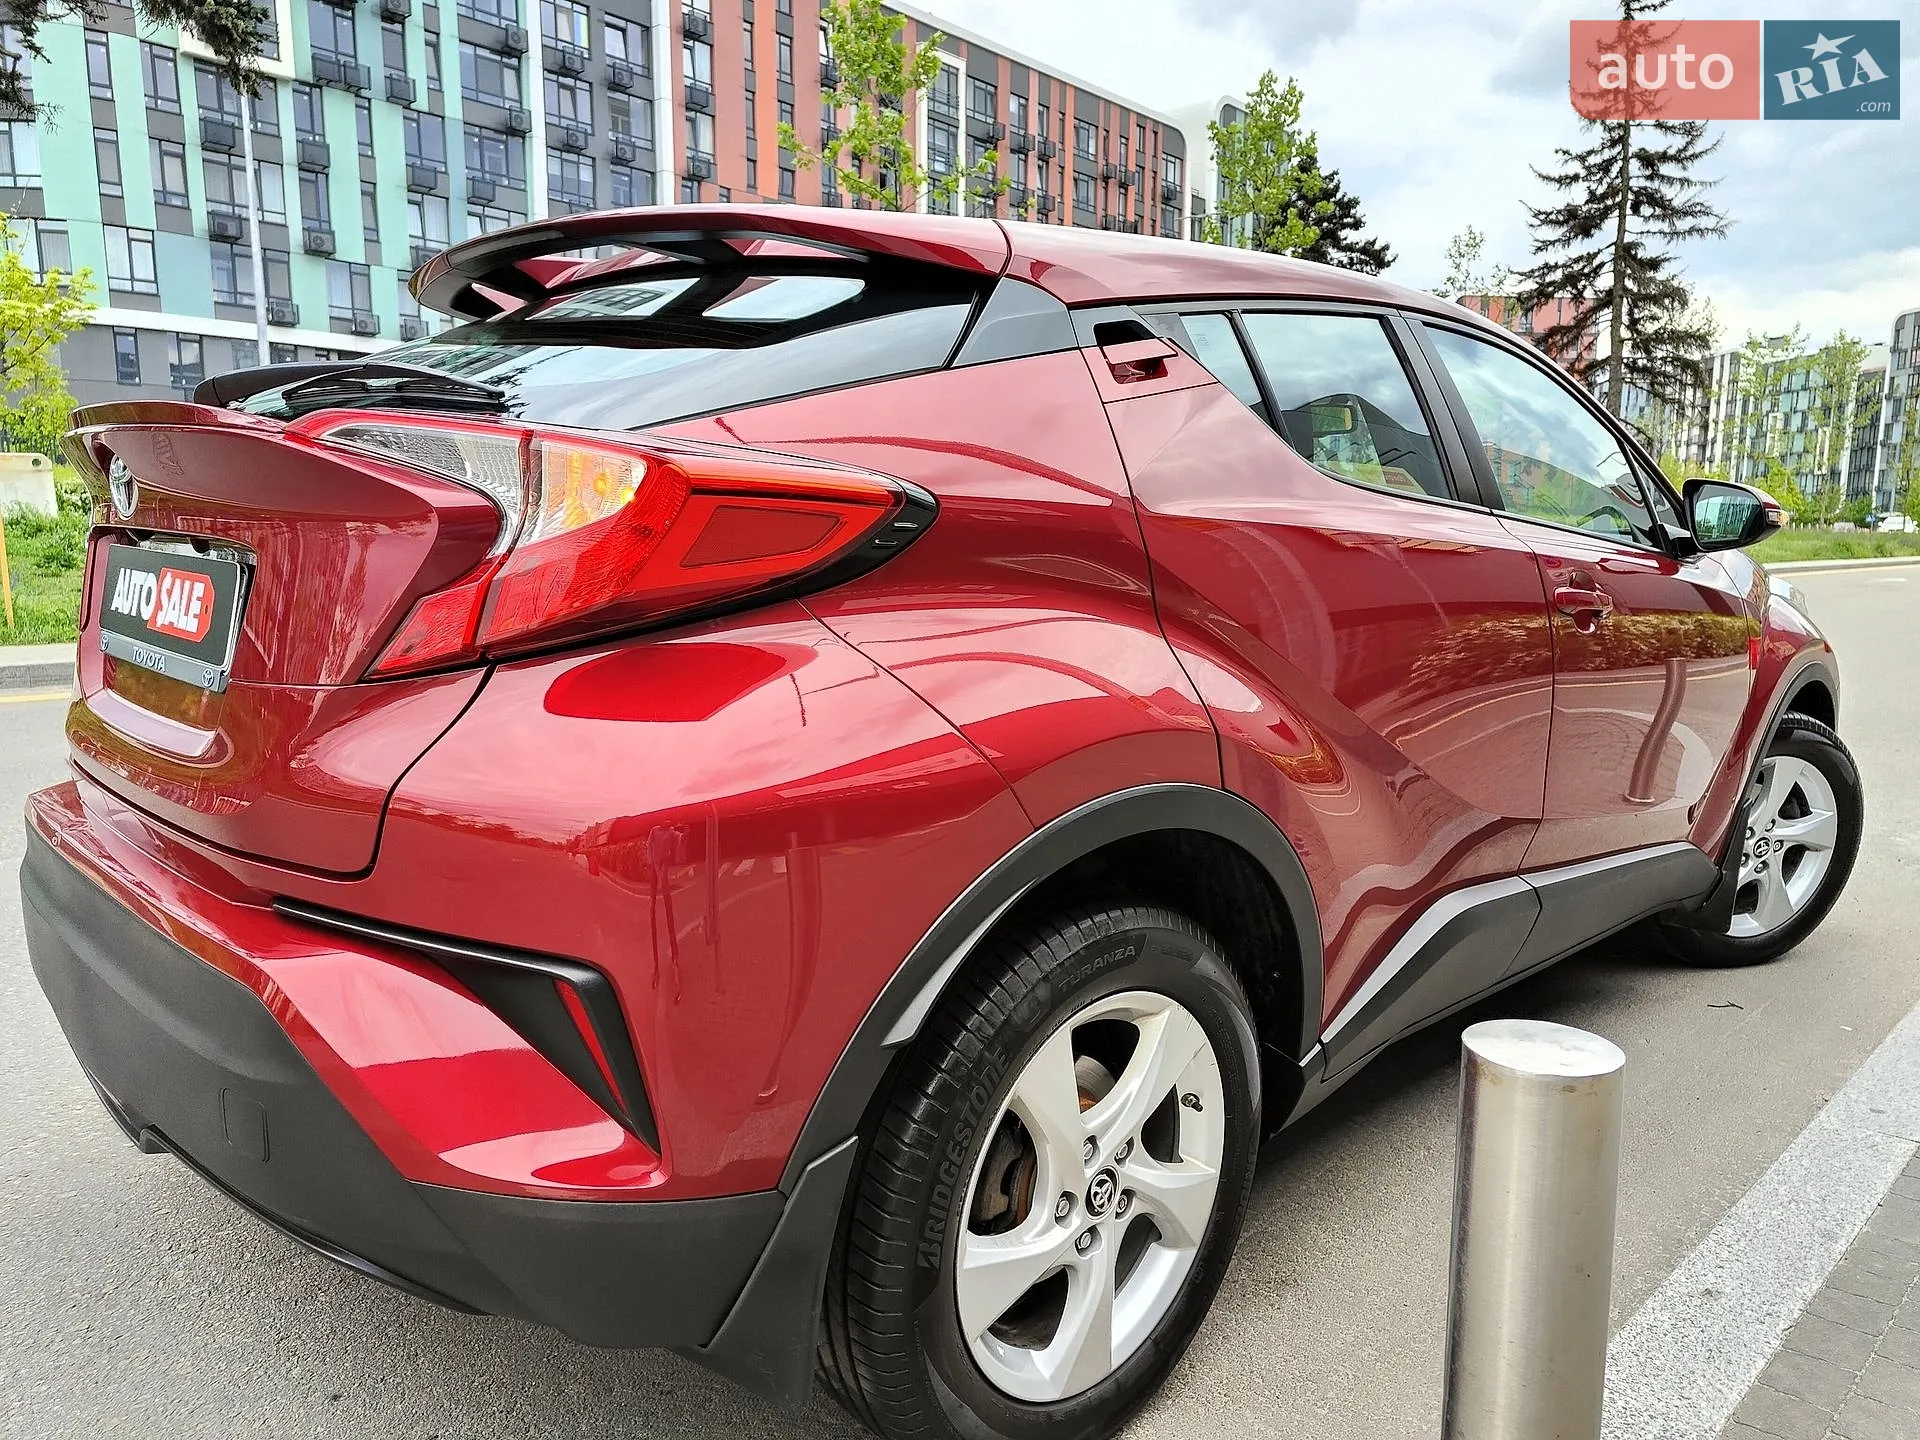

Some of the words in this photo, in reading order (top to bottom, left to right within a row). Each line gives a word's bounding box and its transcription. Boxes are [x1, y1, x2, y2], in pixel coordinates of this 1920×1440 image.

[110, 567, 156, 621] AUTO
[132, 647, 167, 673] TOYOTA
[916, 1045, 1010, 1269] BRIDGESTONE
